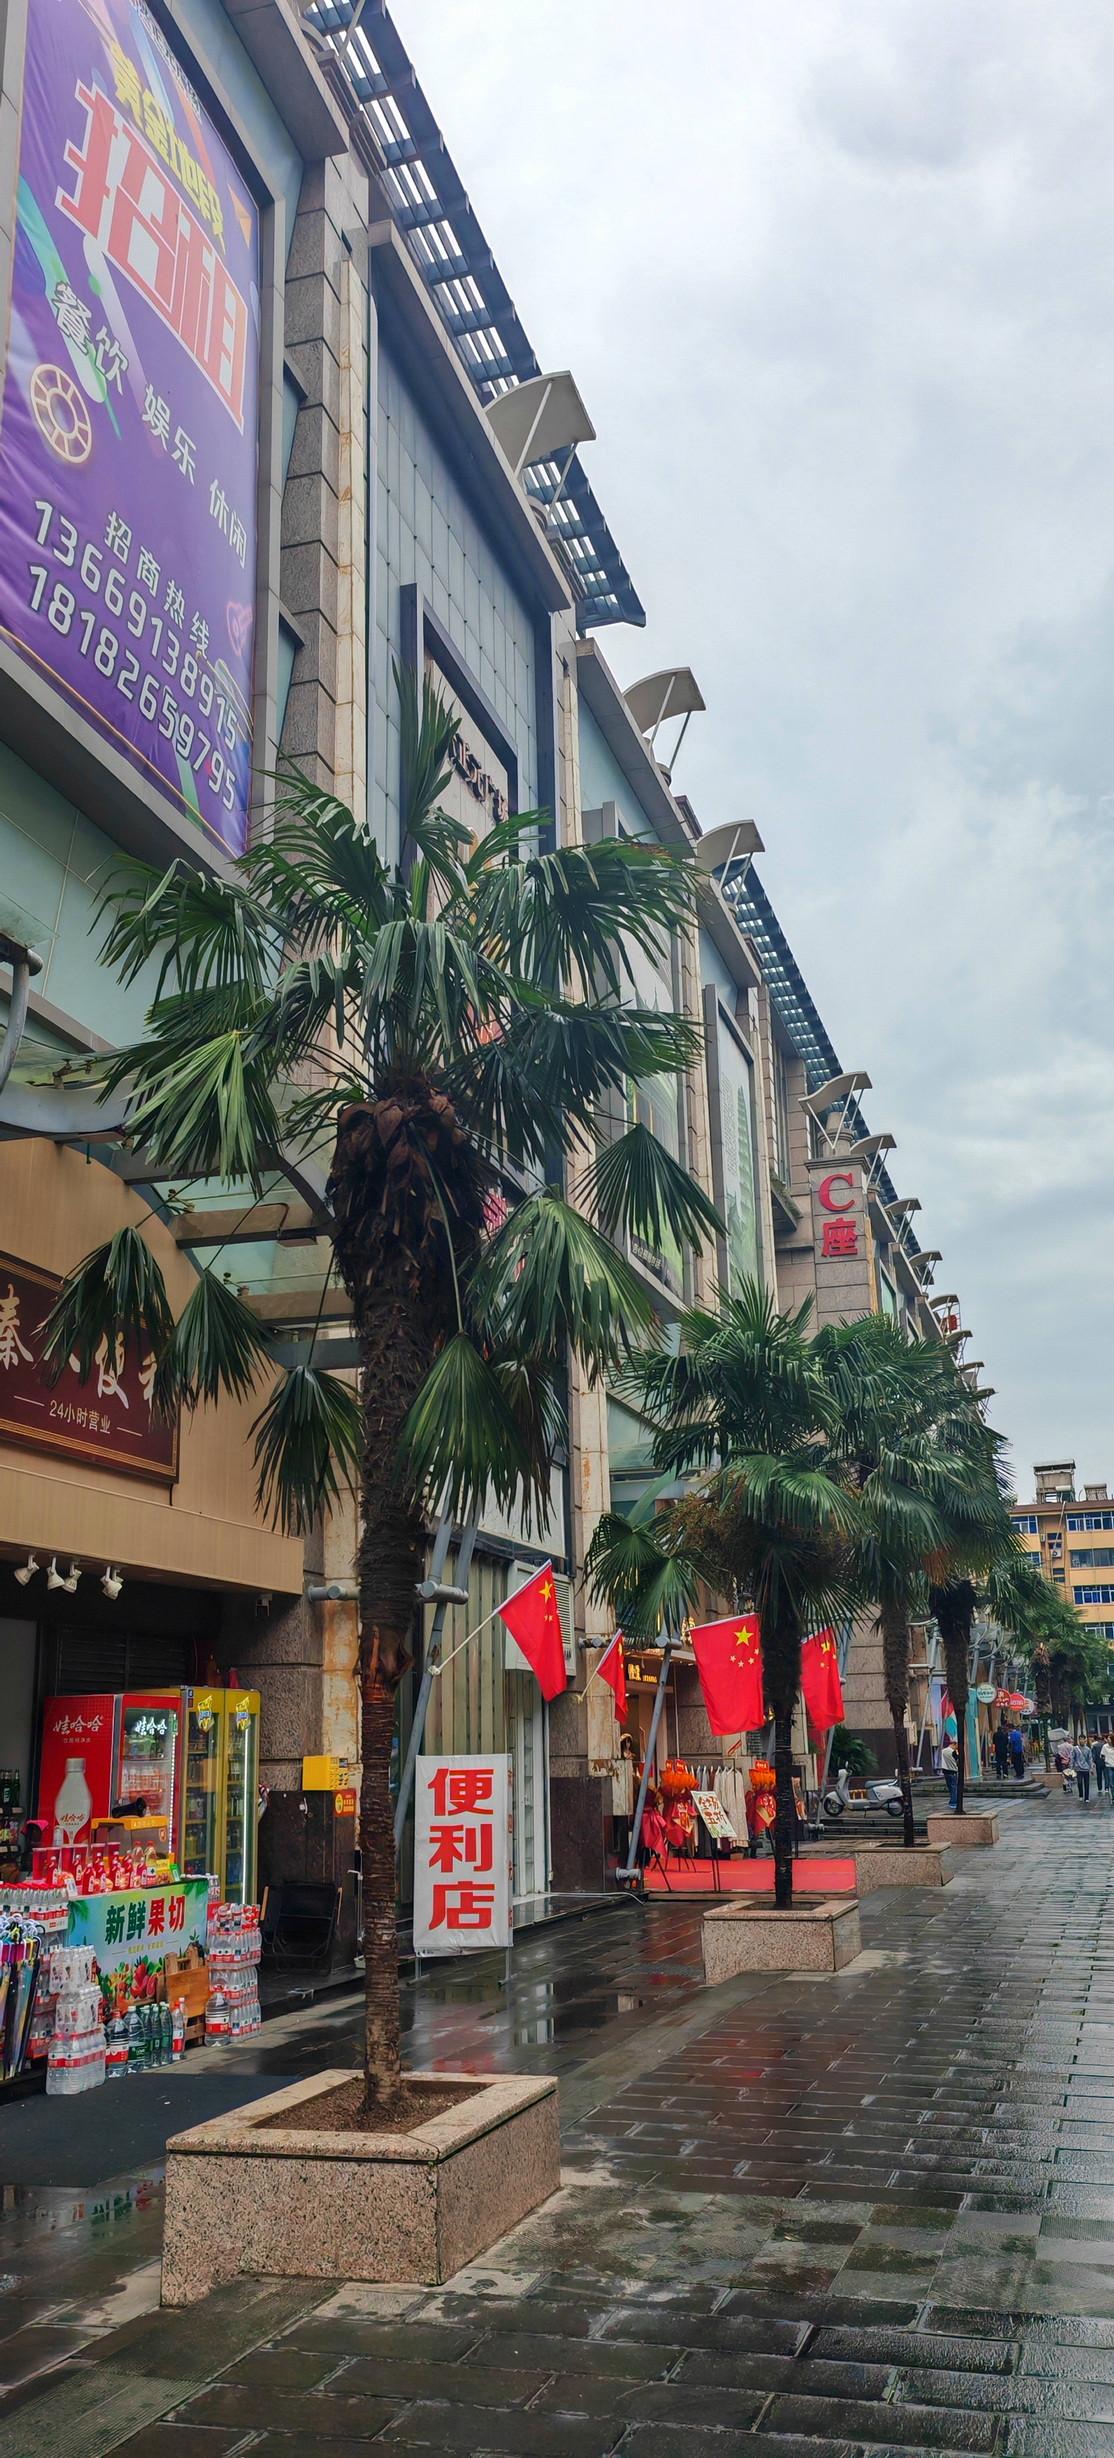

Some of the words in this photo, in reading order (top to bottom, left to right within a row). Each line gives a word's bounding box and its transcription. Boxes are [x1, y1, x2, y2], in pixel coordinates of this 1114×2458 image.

[110, 40, 226, 254] 黄金地段
[55, 78, 249, 435] 招租
[52, 281, 130, 395] 餐饮
[141, 383, 196, 486] 娱乐
[209, 479, 248, 569] 休闲
[33, 499, 240, 751] 13669138915
[105, 510, 211, 661] 招商热线
[28, 564, 237, 812] 18182659795
[819, 1172, 858, 1257] C座
[49, 1399, 111, 1435] 24小时营业
[53, 1714, 104, 1735] 娃哈哈
[135, 1716, 168, 1736] 娃哈哈
[104, 1895, 186, 1945] 新鲜果切
[427, 1767, 495, 1932] 便利店
